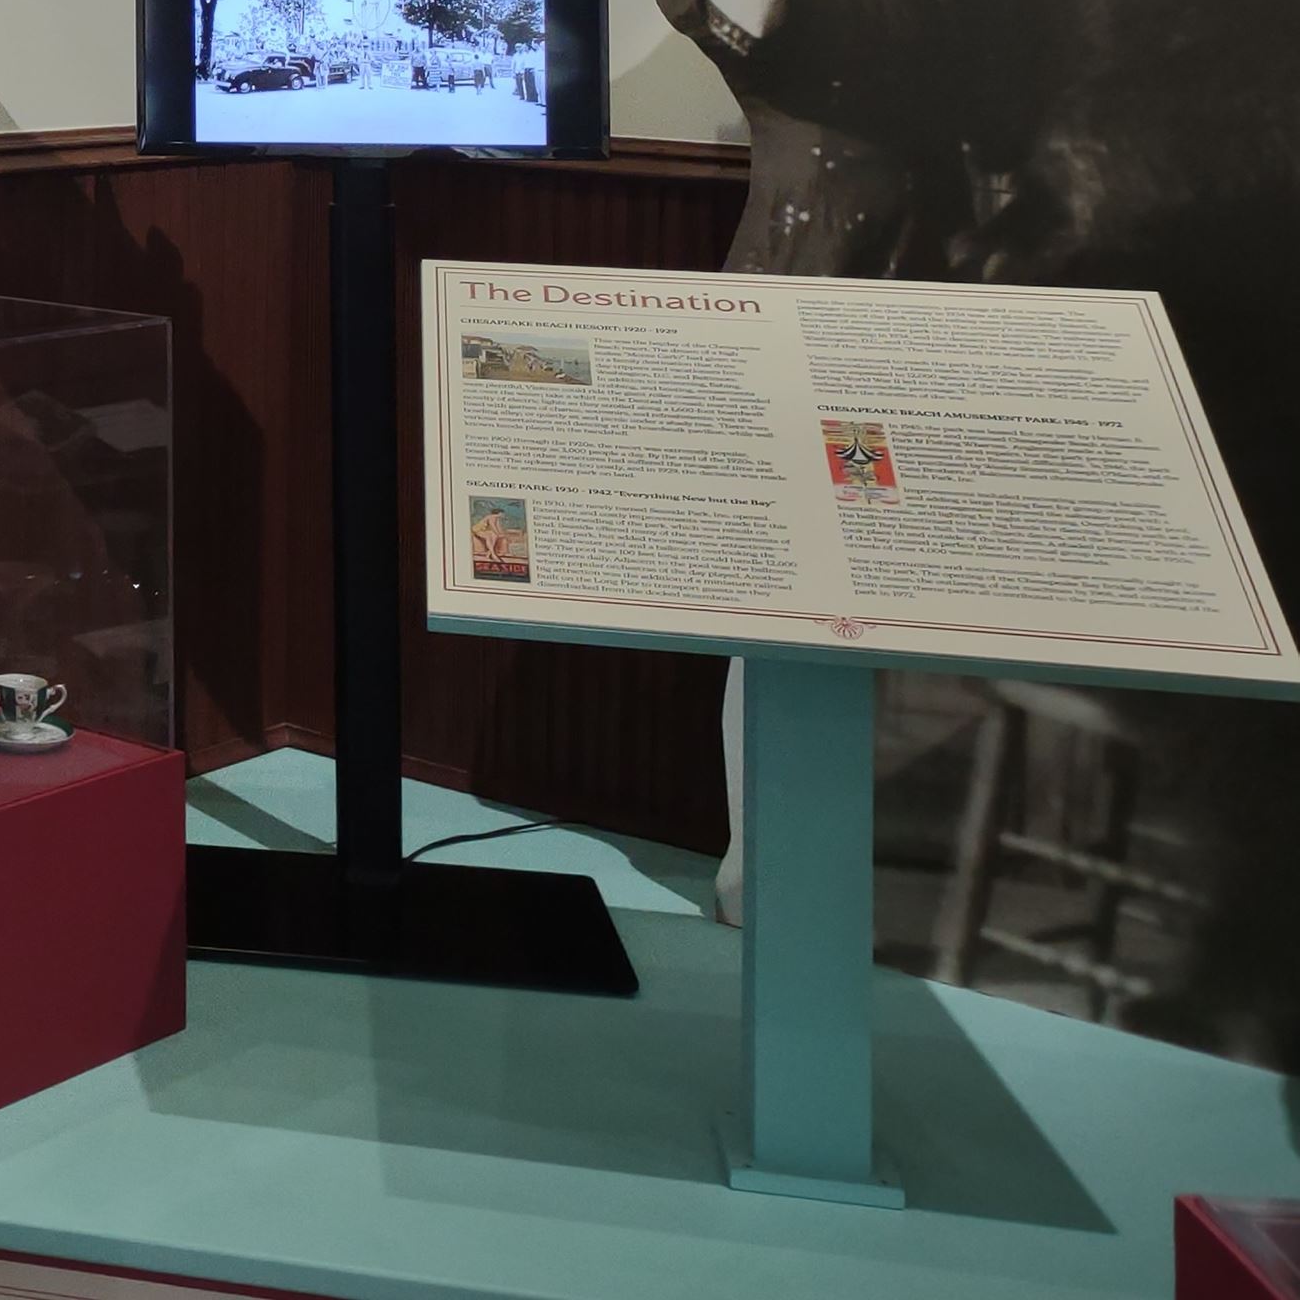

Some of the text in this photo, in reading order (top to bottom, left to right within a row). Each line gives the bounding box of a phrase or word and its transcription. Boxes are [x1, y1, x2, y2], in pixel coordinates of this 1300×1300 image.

[459, 281, 763, 314] The Destination
[460, 318, 533, 326] CHESAPEAKE
[816, 405, 899, 414] CHESAPEAKE
[899, 409, 941, 417] BEACH
[942, 412, 1024, 421] AMUSEMENT
[465, 480, 516, 488] SEASIDE
